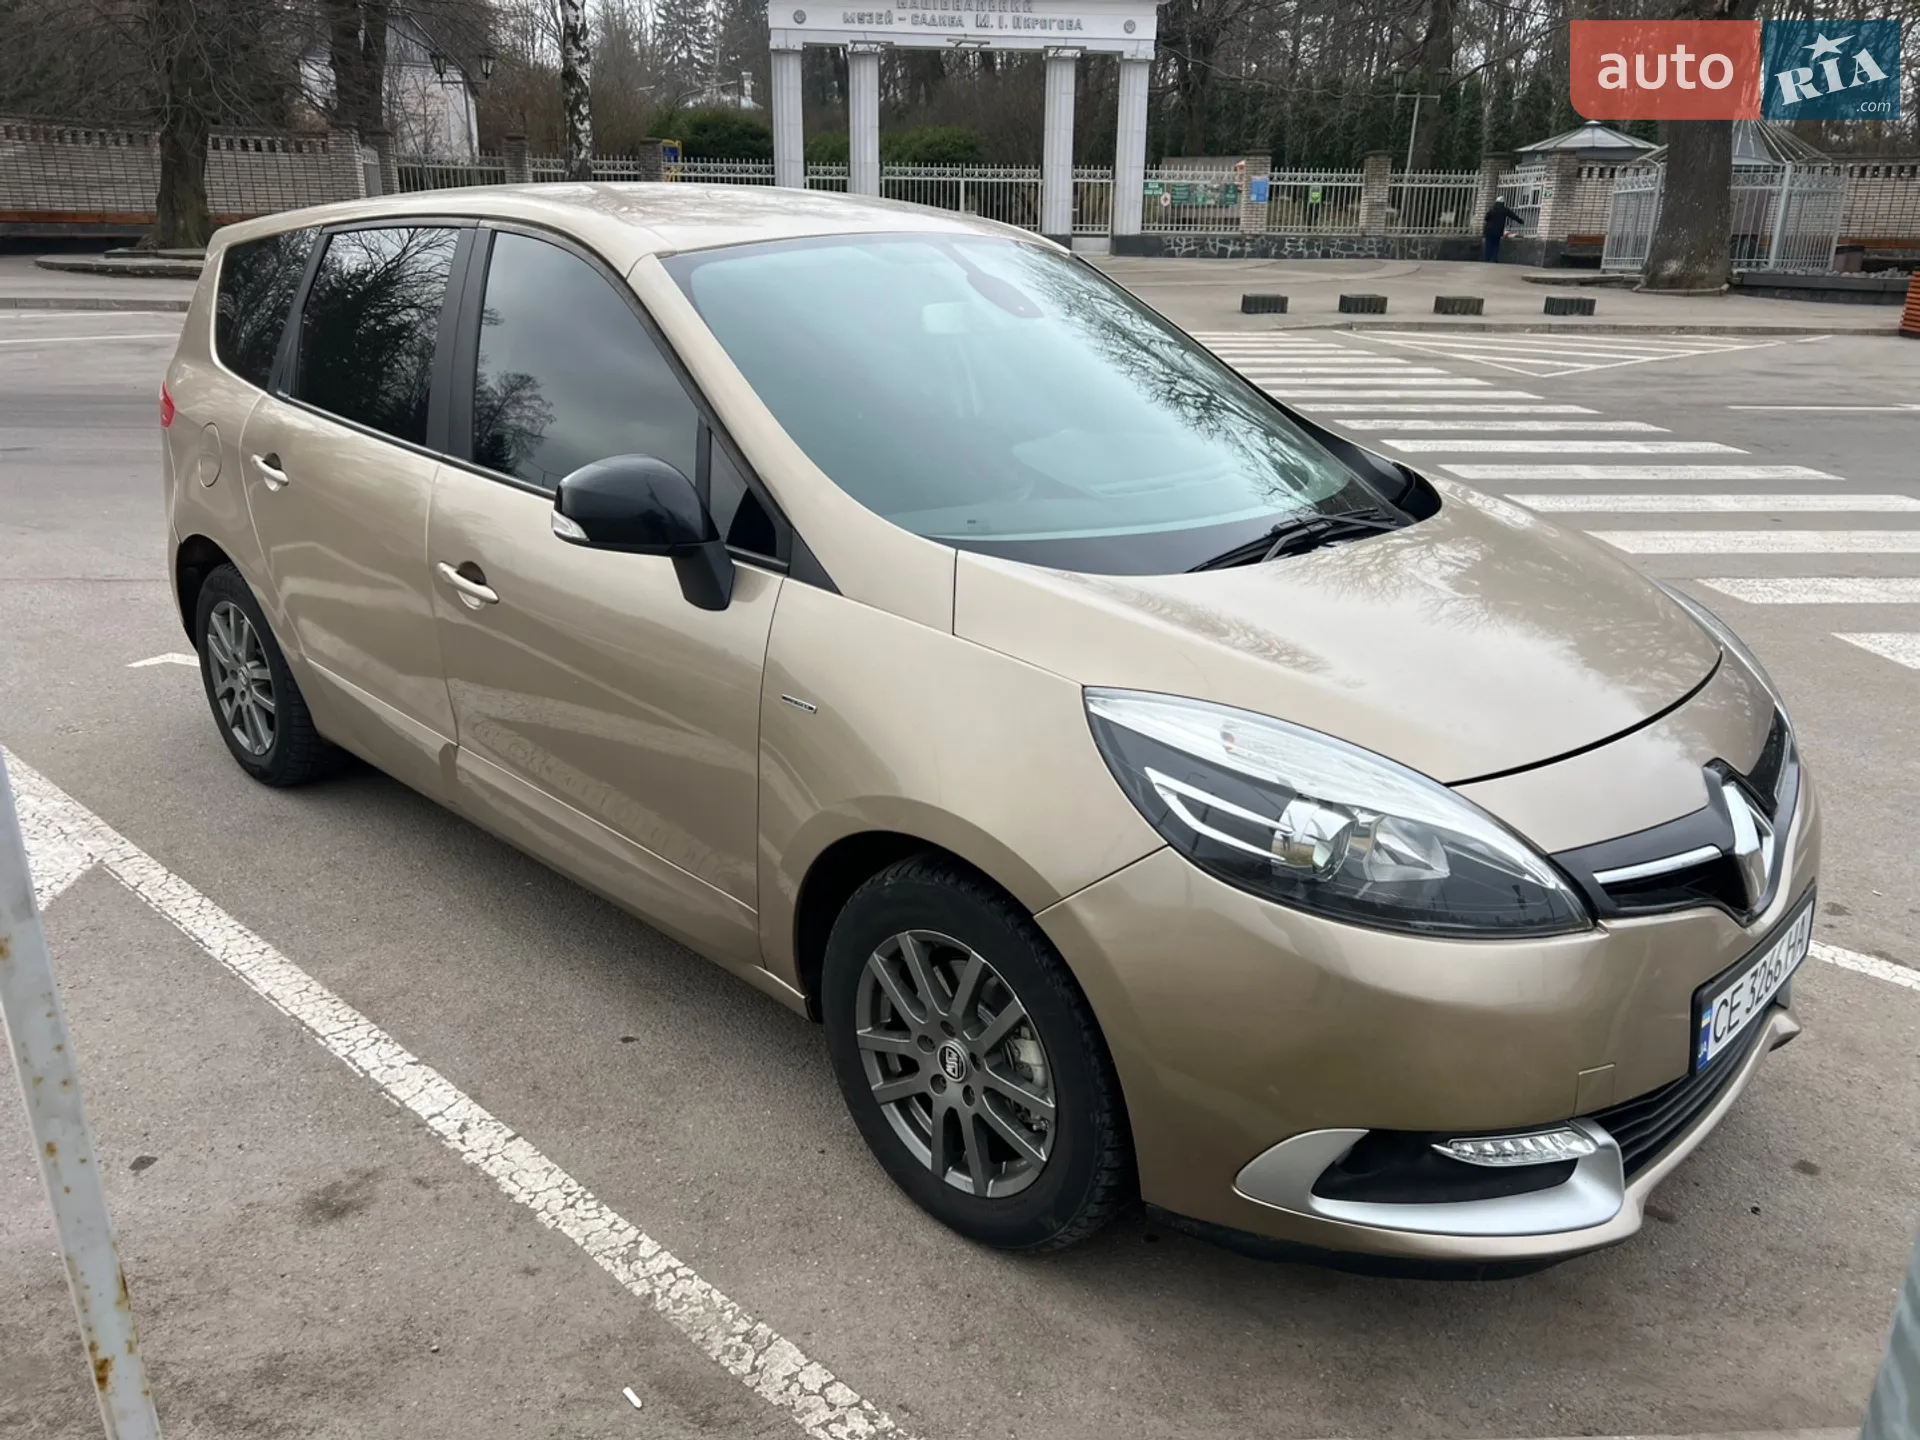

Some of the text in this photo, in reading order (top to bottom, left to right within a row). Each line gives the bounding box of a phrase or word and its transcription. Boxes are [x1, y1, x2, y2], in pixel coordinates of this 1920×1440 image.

[842, 10, 894, 25] МУЗЕЙ
[910, 13, 965, 28] САДИБА
[1012, 15, 1084, 31] ПИРОГОВА
[1713, 982, 1744, 1043] CE
[1745, 938, 1784, 1014] 3266
